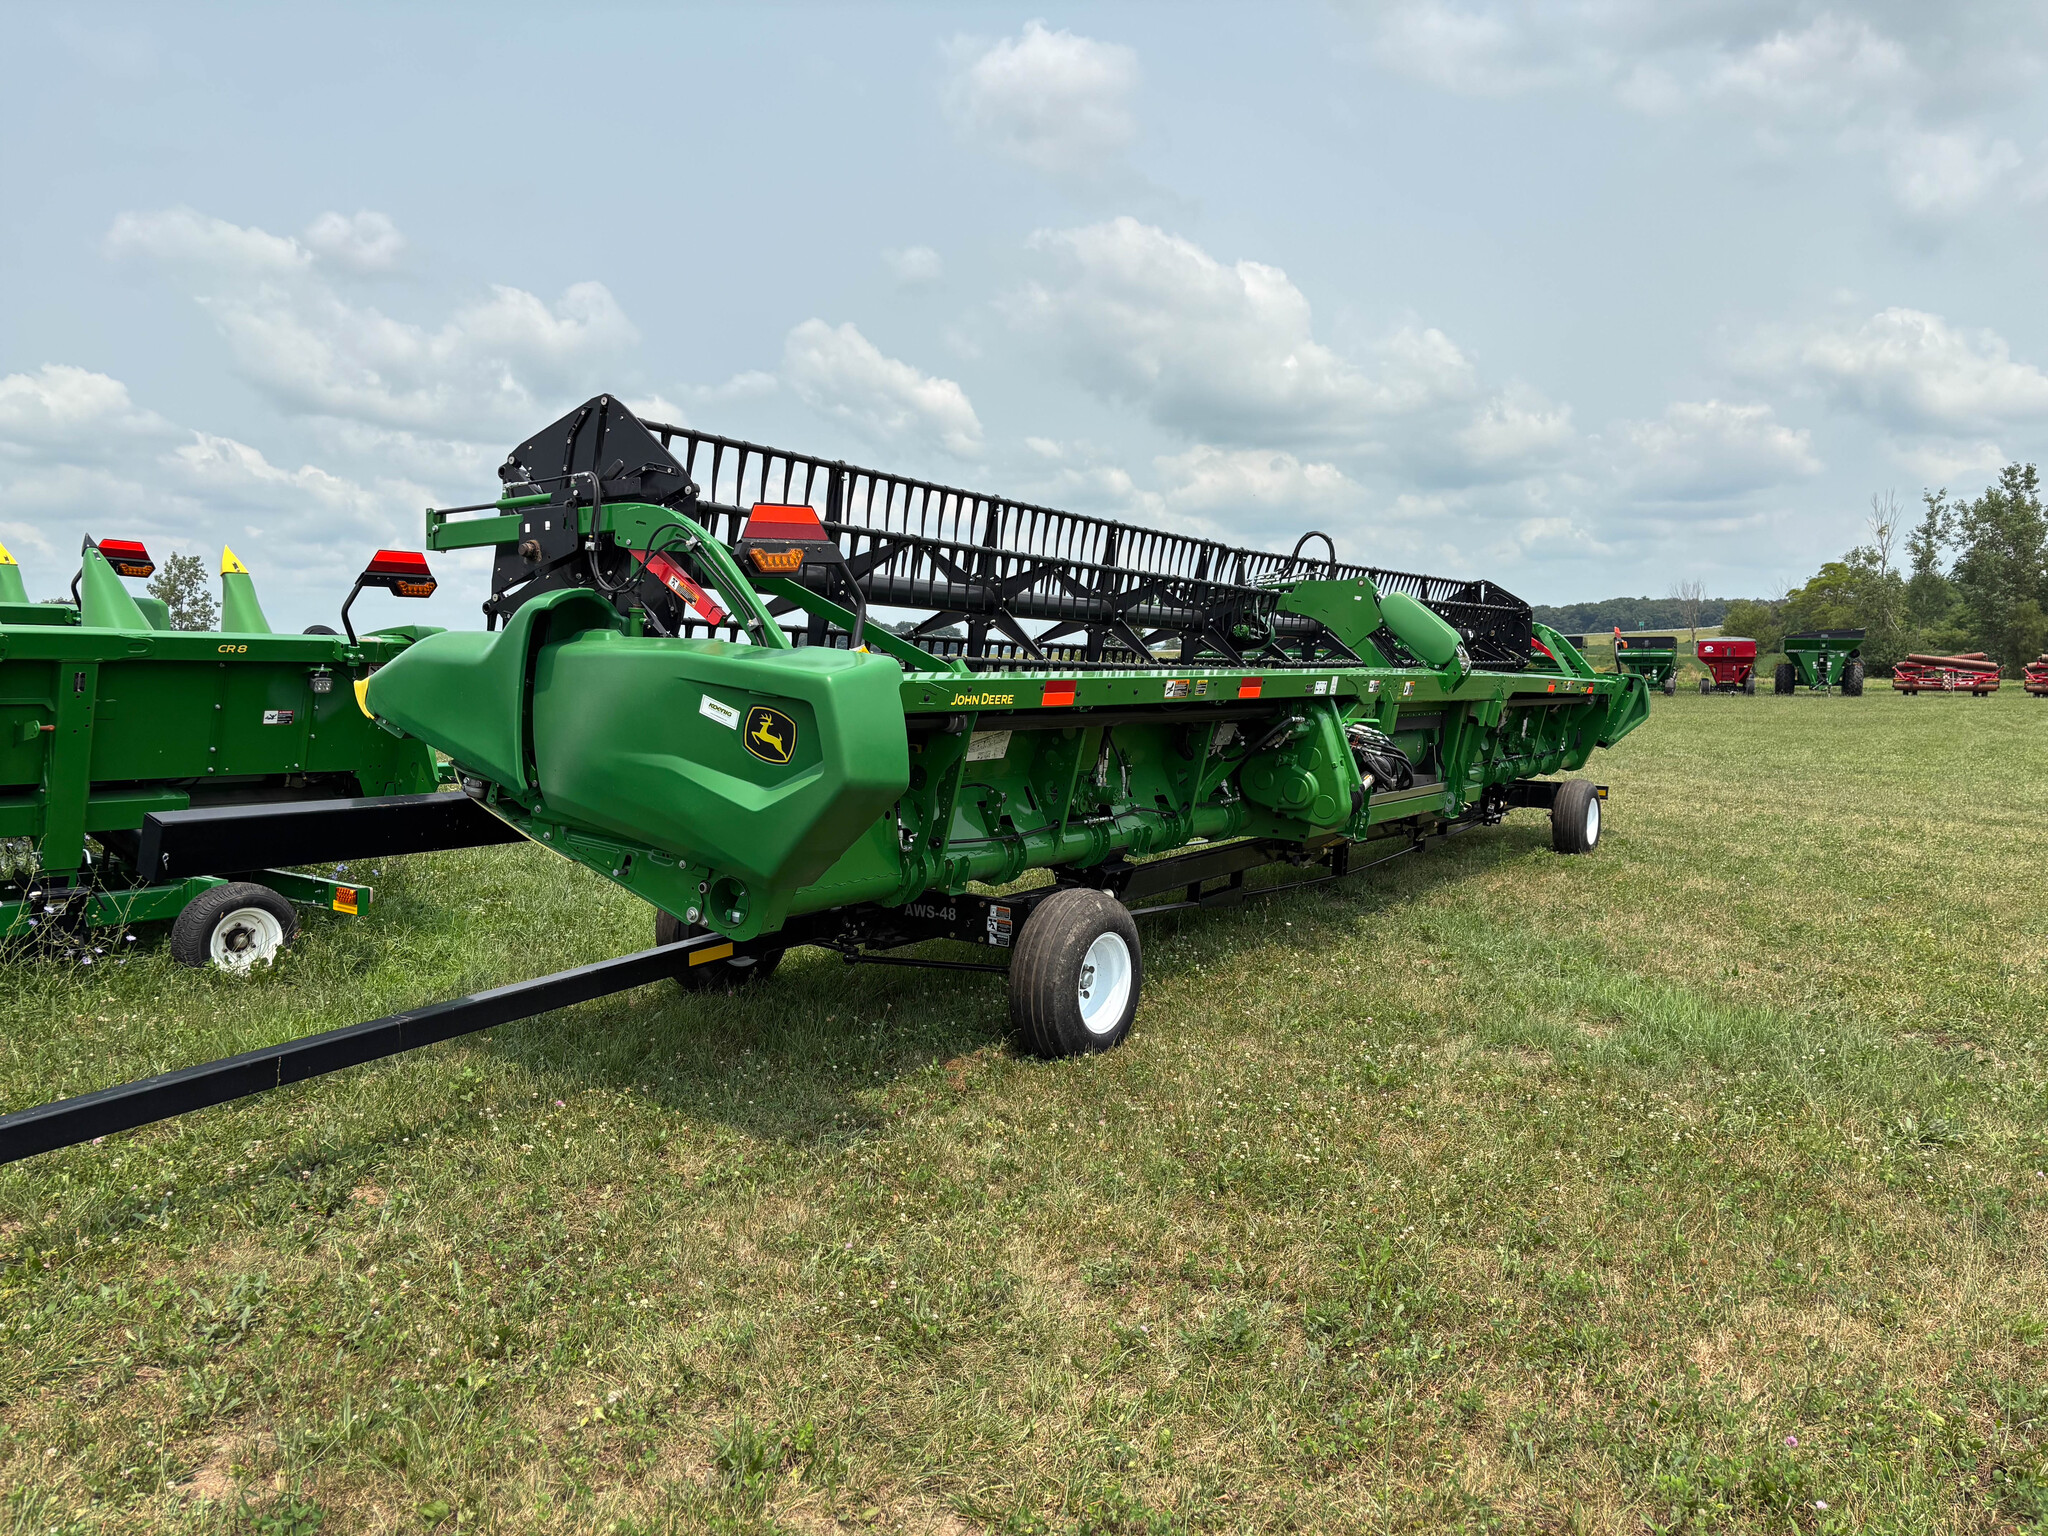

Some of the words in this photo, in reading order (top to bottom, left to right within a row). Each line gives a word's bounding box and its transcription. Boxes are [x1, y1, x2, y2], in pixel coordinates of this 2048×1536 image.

[217, 644, 236, 653] CR
[237, 644, 248, 653] 8
[950, 693, 979, 706] JOHN
[980, 692, 1014, 705] DEERE
[904, 903, 956, 921] AWS-48
